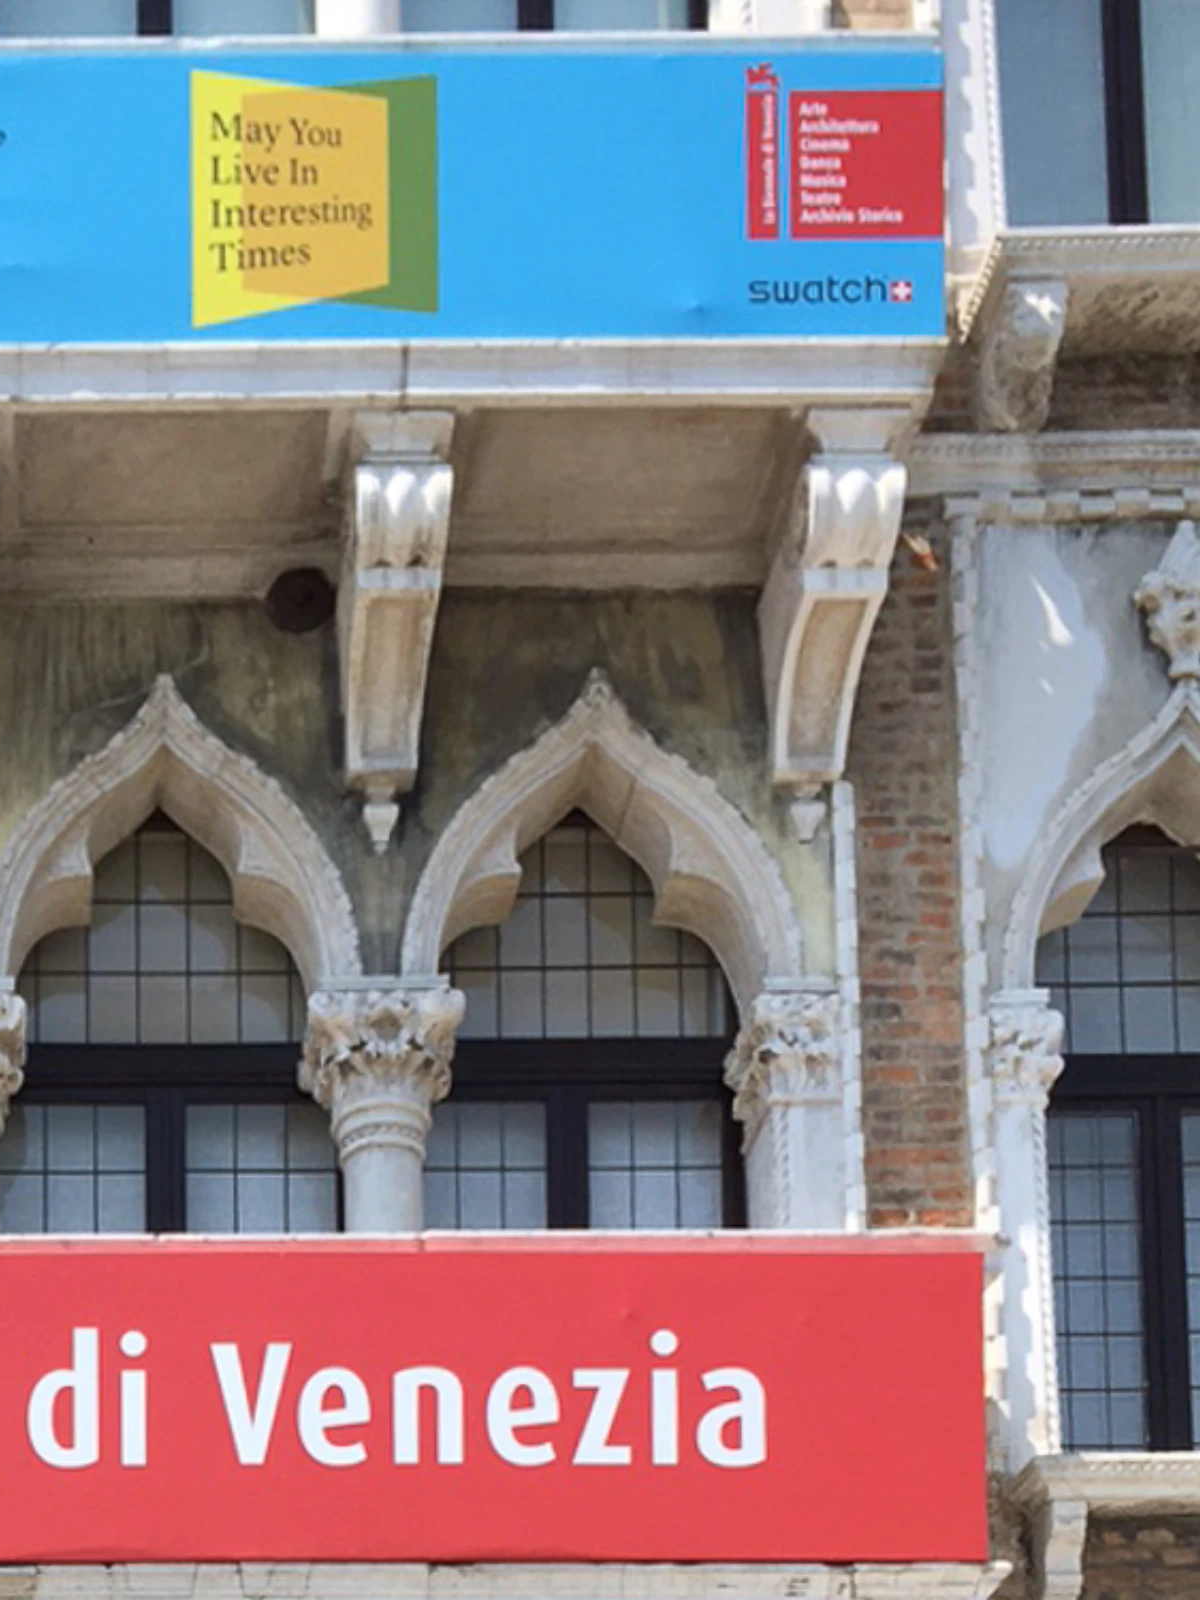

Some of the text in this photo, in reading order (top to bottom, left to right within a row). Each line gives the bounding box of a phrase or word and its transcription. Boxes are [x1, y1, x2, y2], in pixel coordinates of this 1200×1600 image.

[798, 102, 828, 116] Arte
[210, 111, 343, 153] May You
[798, 119, 880, 134] Architettura
[800, 137, 851, 152] Cinema
[210, 154, 318, 186] Live In
[799, 173, 847, 188] Musica
[211, 196, 373, 231] Interesting
[210, 239, 311, 273] Times
[748, 274, 887, 304] swatch
[25, 1326, 148, 1469] di
[211, 1328, 767, 1468] Venezia
